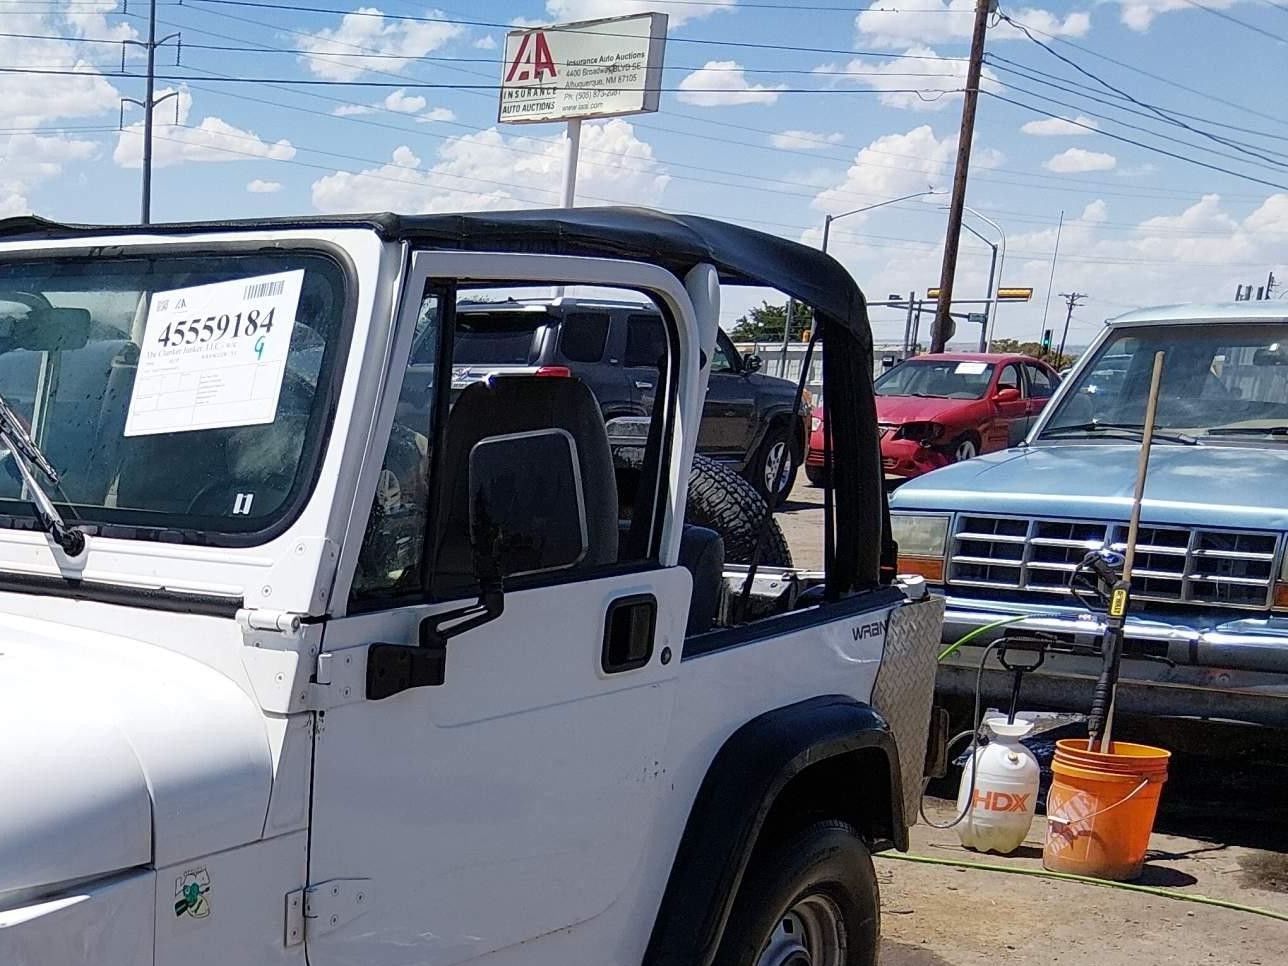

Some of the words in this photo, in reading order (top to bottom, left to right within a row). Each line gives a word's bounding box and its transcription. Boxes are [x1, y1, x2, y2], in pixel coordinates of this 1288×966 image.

[566, 58, 598, 66] Insurance
[599, 55, 614, 63] Auto
[616, 52, 645, 60] Auctions
[503, 87, 557, 100] INSURANCE
[502, 104, 521, 114] AUTO
[522, 101, 556, 112] AUCTIONS
[158, 306, 276, 348] 45559184
[973, 788, 1031, 812] HDX
